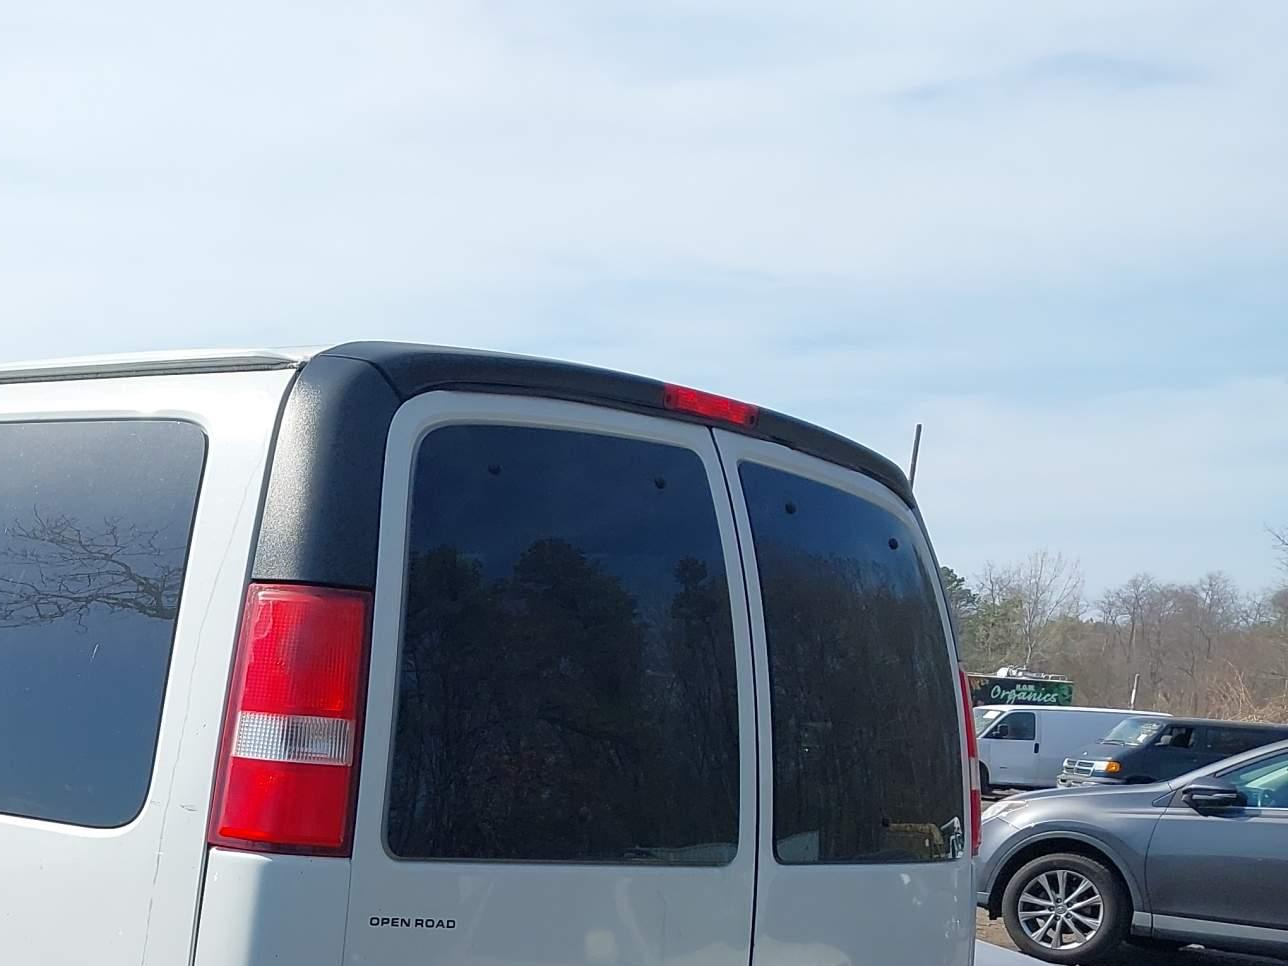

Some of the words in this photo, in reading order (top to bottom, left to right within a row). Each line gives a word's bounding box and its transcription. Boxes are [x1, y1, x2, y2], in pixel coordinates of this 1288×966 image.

[991, 685, 1058, 703] Organics
[369, 917, 411, 928] OPEN
[414, 918, 456, 929] ROAD
